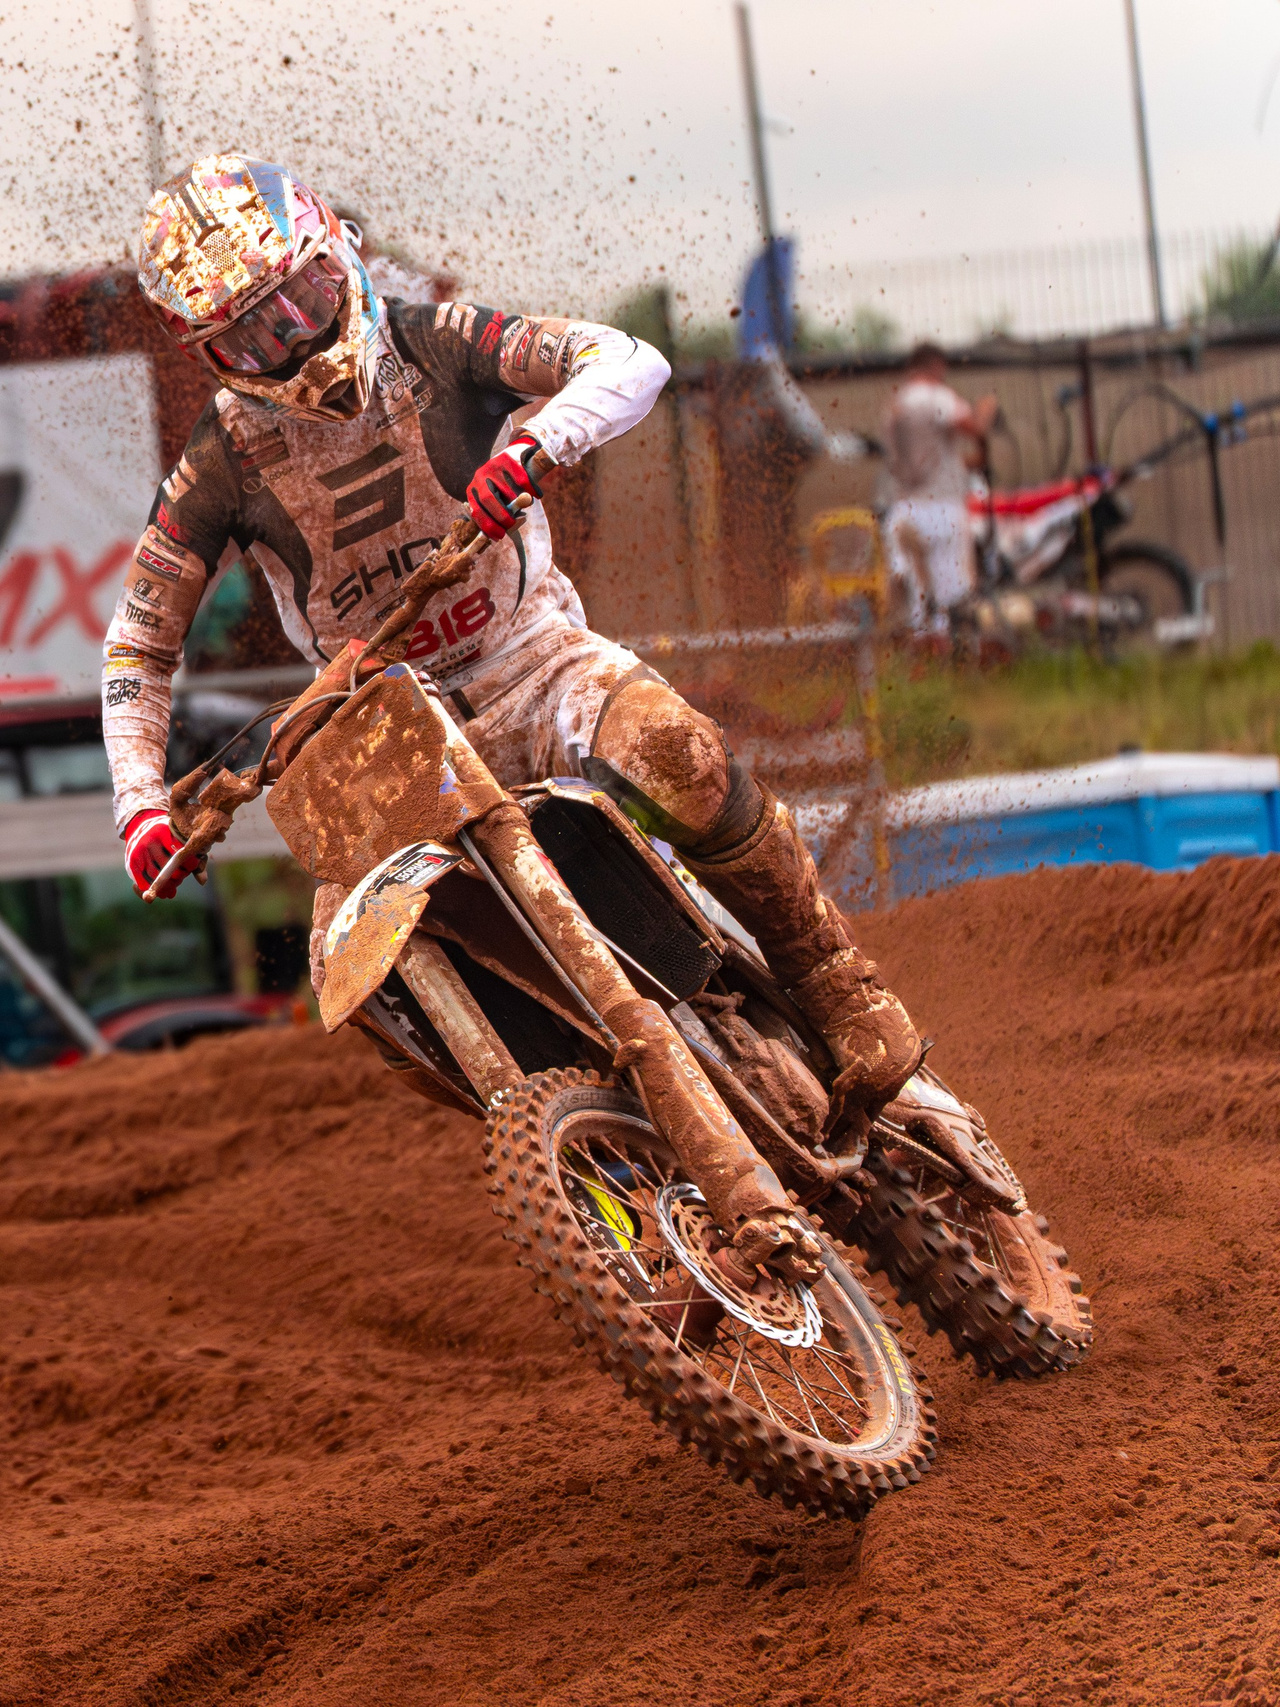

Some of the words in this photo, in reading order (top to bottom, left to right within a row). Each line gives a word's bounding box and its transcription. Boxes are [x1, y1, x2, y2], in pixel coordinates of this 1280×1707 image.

[140, 549, 180, 573] WRP
[330, 535, 447, 621] SHO
[403, 587, 496, 660] 818
[874, 1323, 912, 1395] PIRELLI
